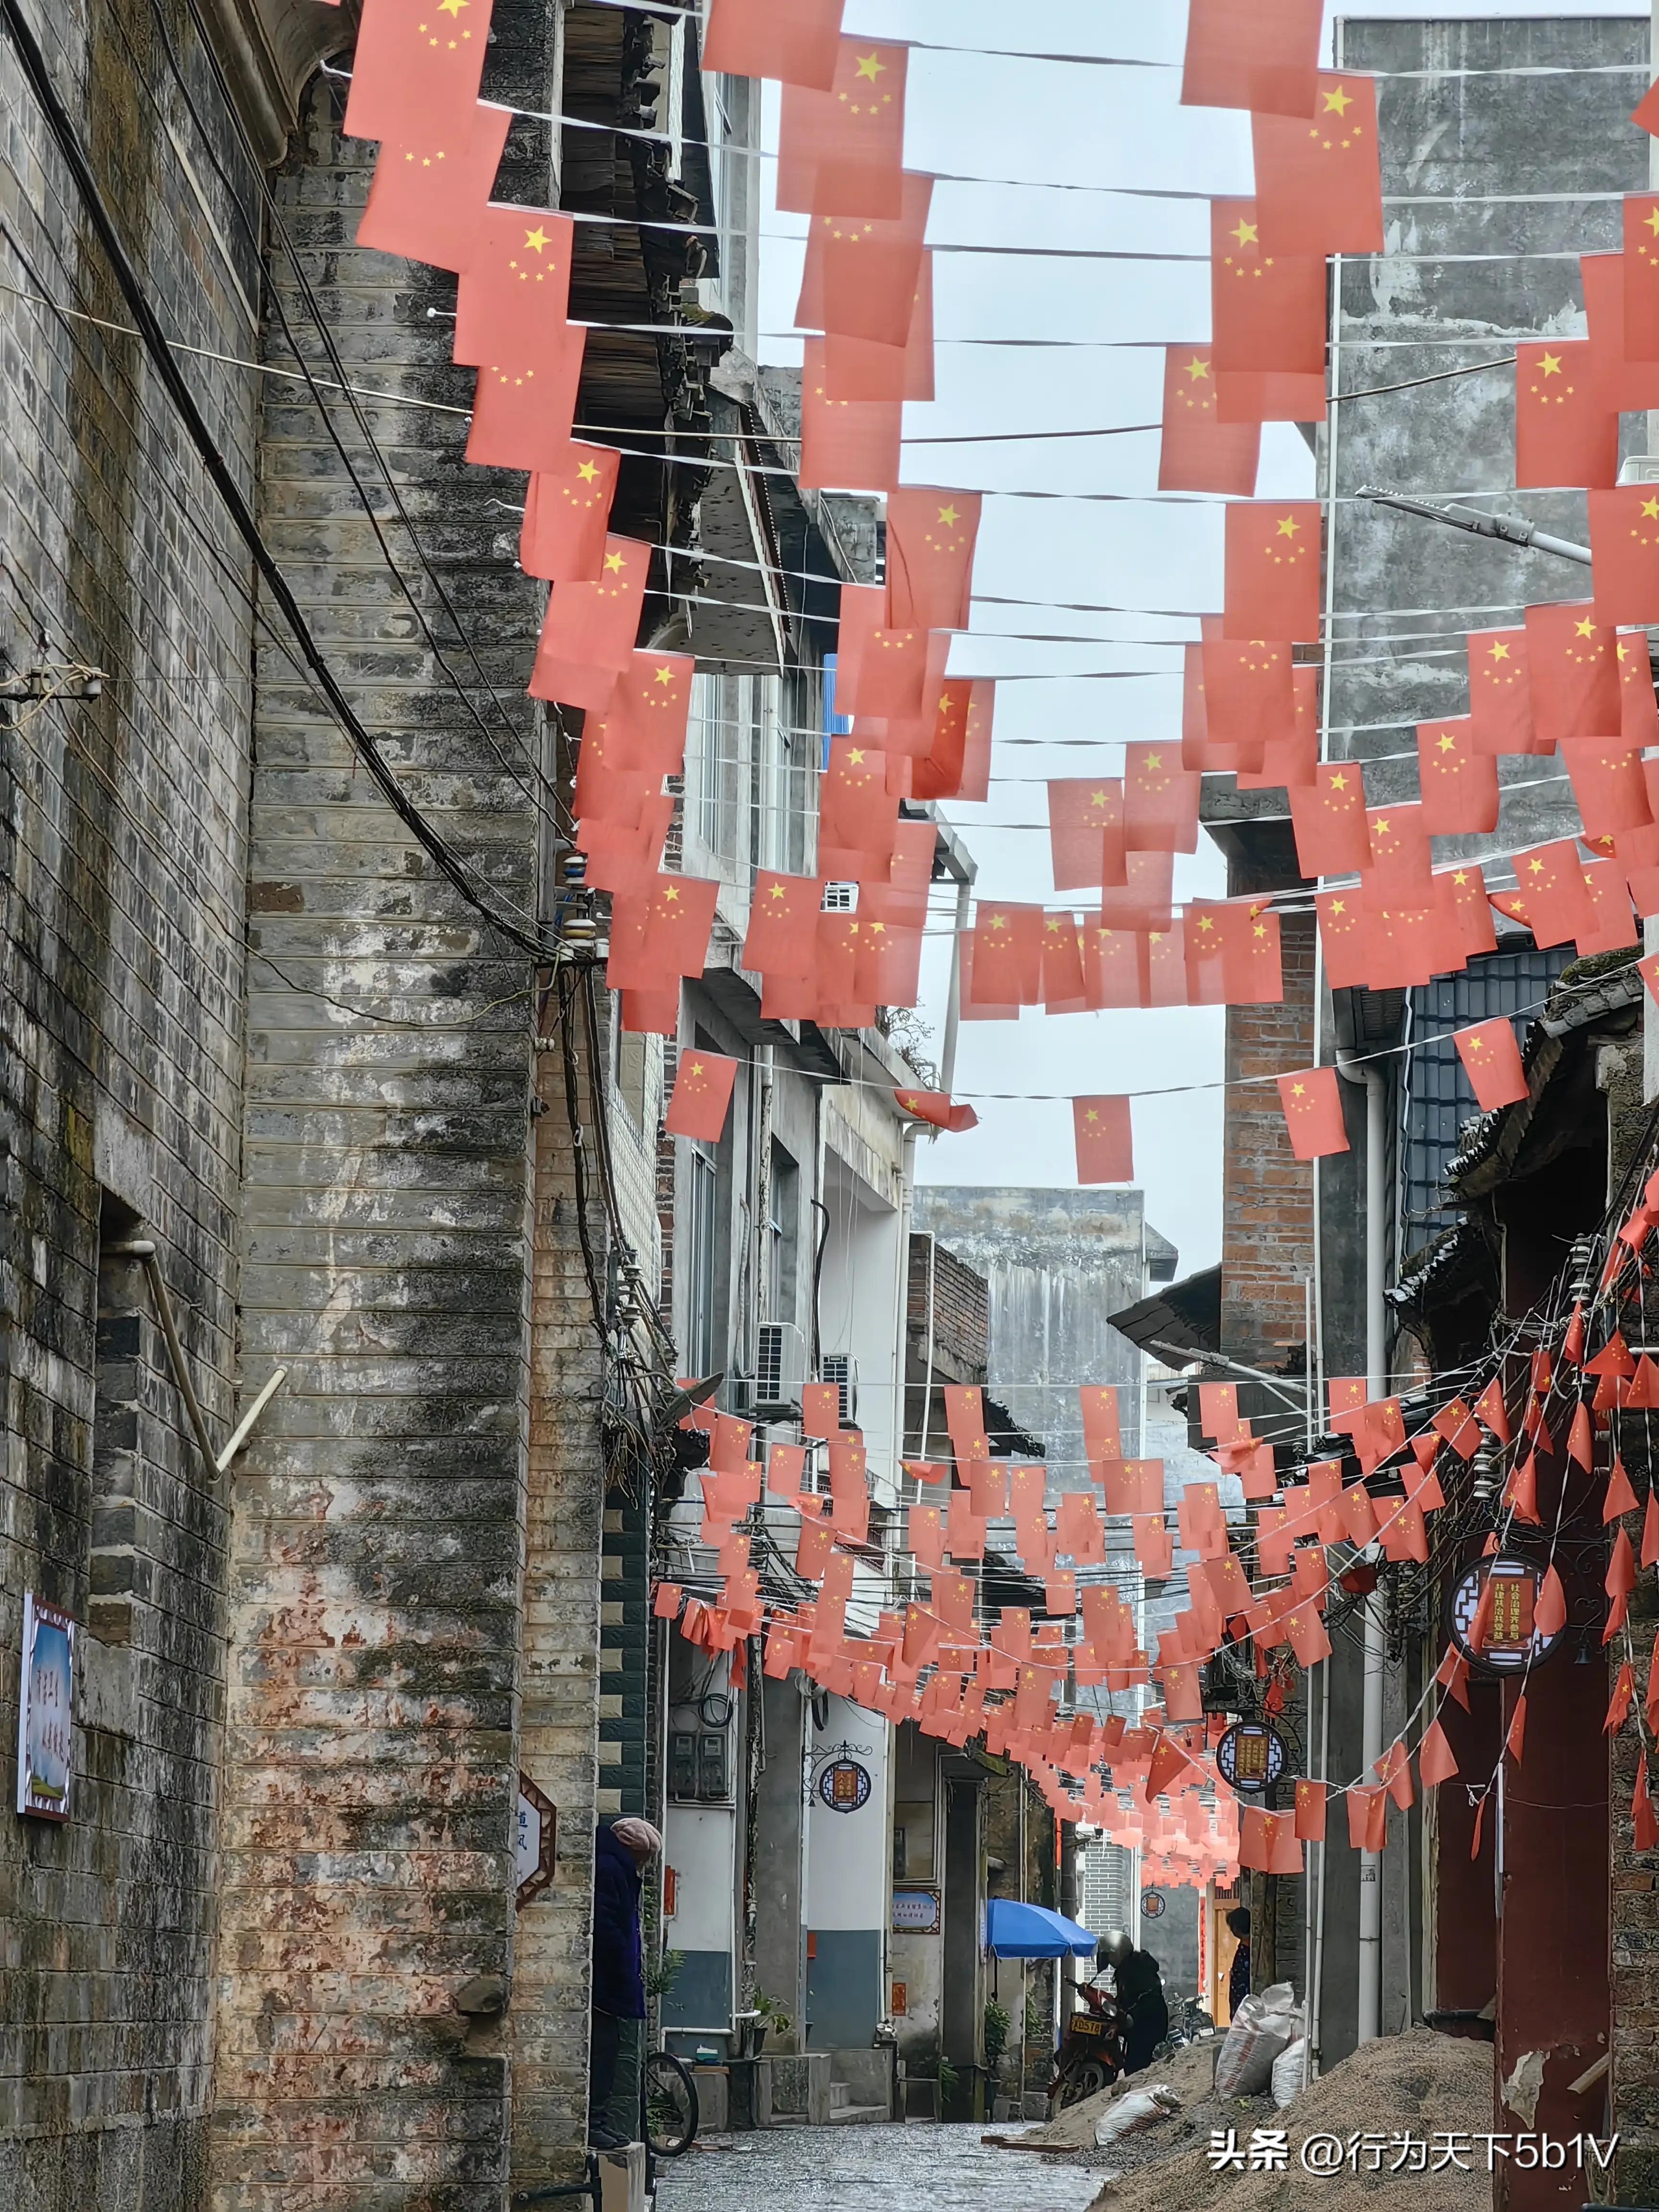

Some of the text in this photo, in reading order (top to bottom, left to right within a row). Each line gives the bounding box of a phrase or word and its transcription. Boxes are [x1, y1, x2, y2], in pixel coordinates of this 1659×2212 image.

[1509, 1583, 1519, 1640] 社会治理齐参与
